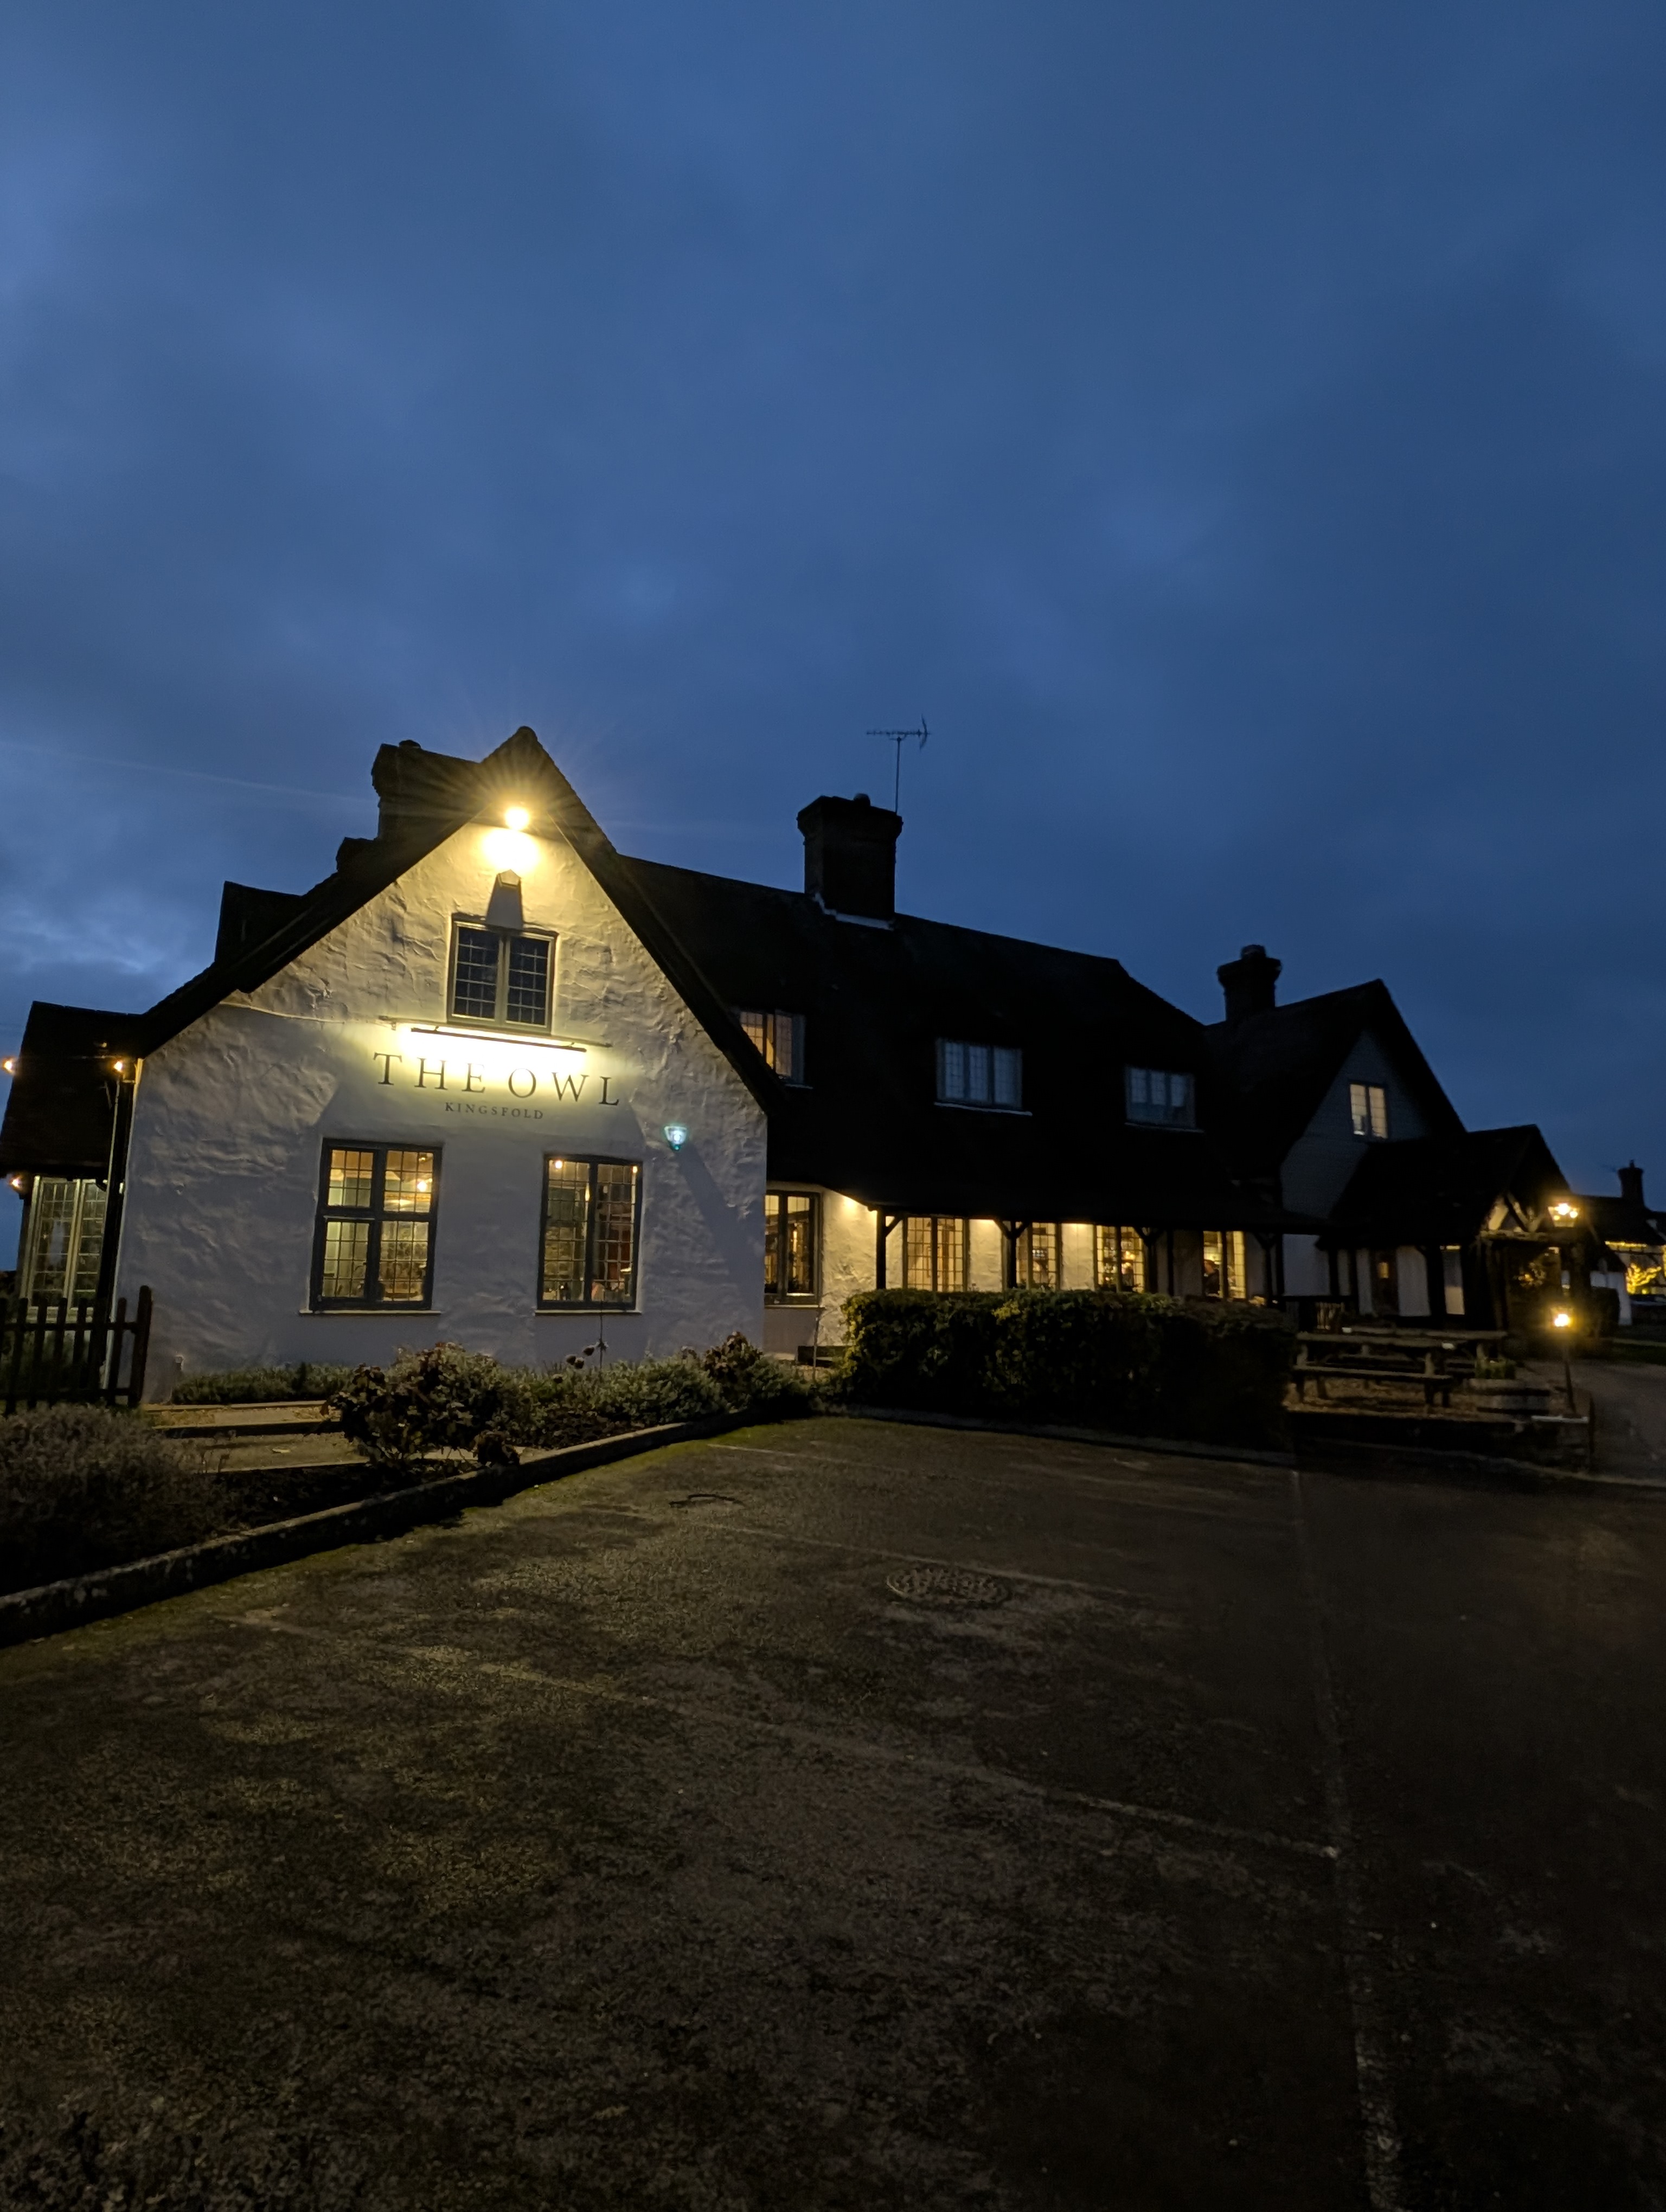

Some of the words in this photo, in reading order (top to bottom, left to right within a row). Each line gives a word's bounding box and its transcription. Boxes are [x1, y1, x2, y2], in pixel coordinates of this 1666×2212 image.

[373, 1052, 485, 1093] THE
[508, 1068, 619, 1105] OWL
[445, 1102, 543, 1120] KINGSFOLD
